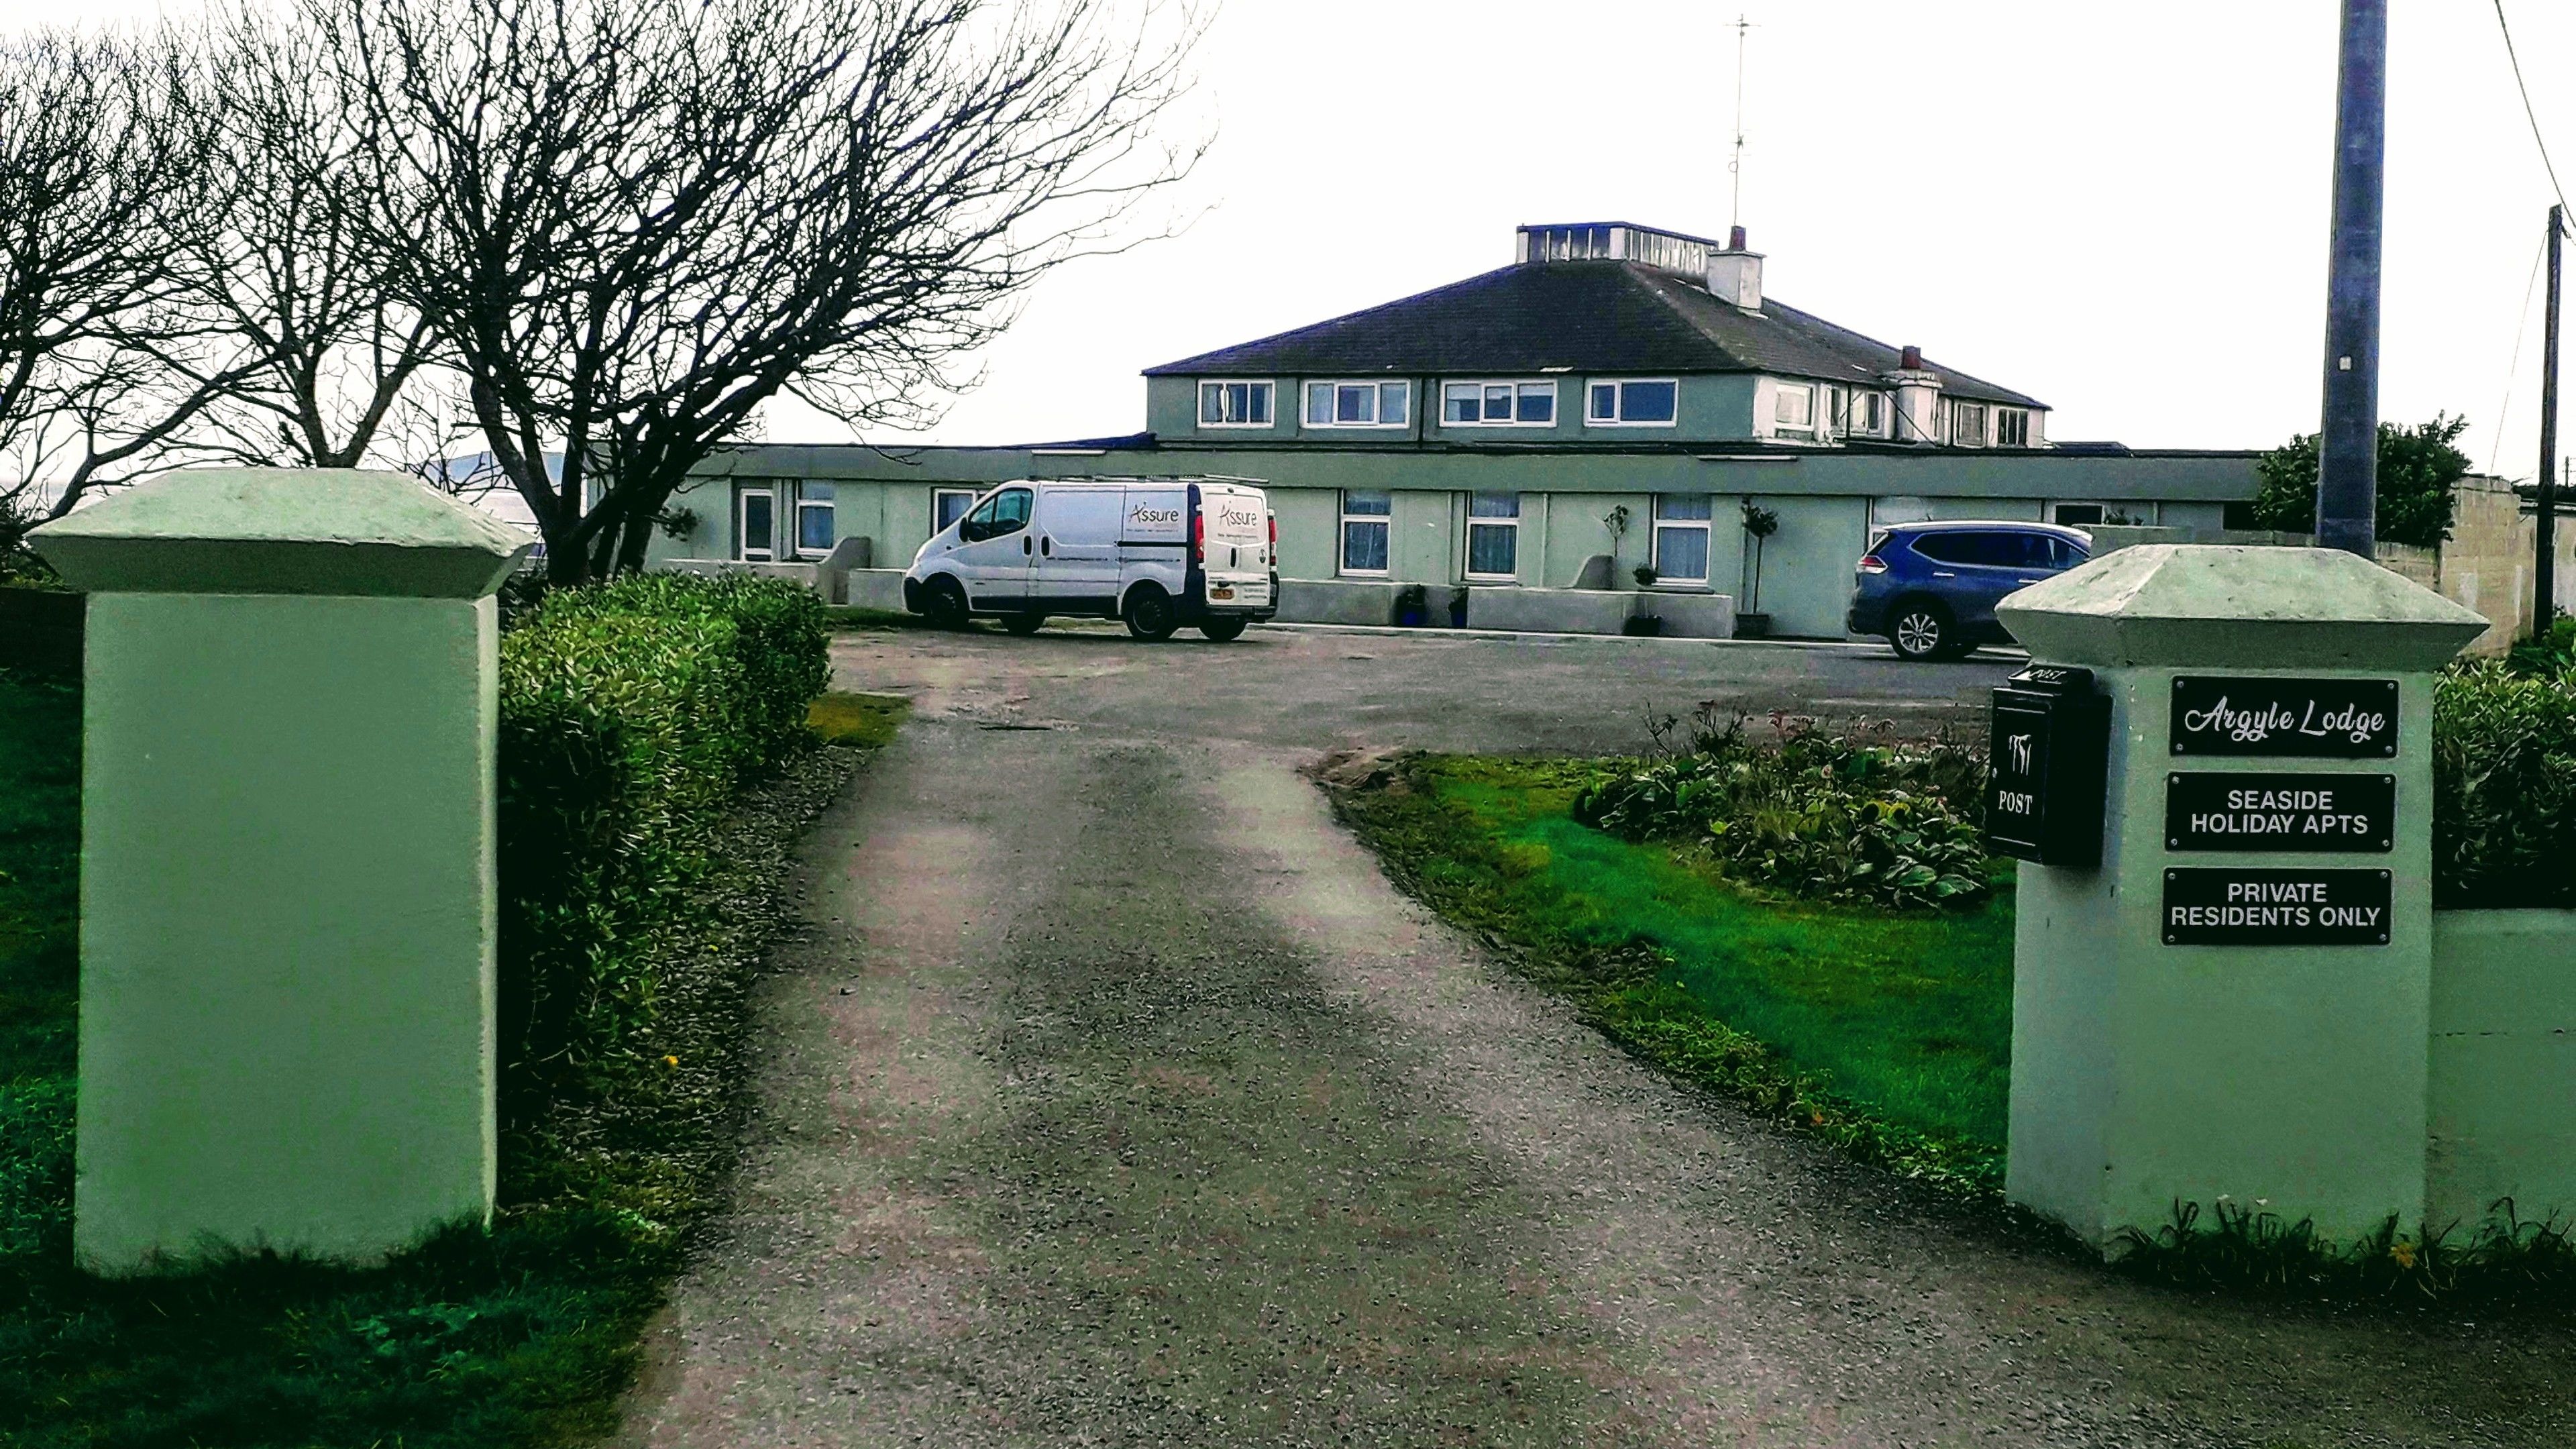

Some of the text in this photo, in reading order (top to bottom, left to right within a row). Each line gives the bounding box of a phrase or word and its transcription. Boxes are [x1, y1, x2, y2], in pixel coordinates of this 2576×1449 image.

[2184, 695, 2385, 743] Argyle Lodge
[1998, 790, 2033, 815] POST
[2227, 790, 2333, 810] SEASIDE
[2191, 813, 2368, 835] HOLIDAY APTS
[2228, 883, 2327, 902] PRIVATE
[2171, 906, 2381, 926] RESIDENTS ONLY
